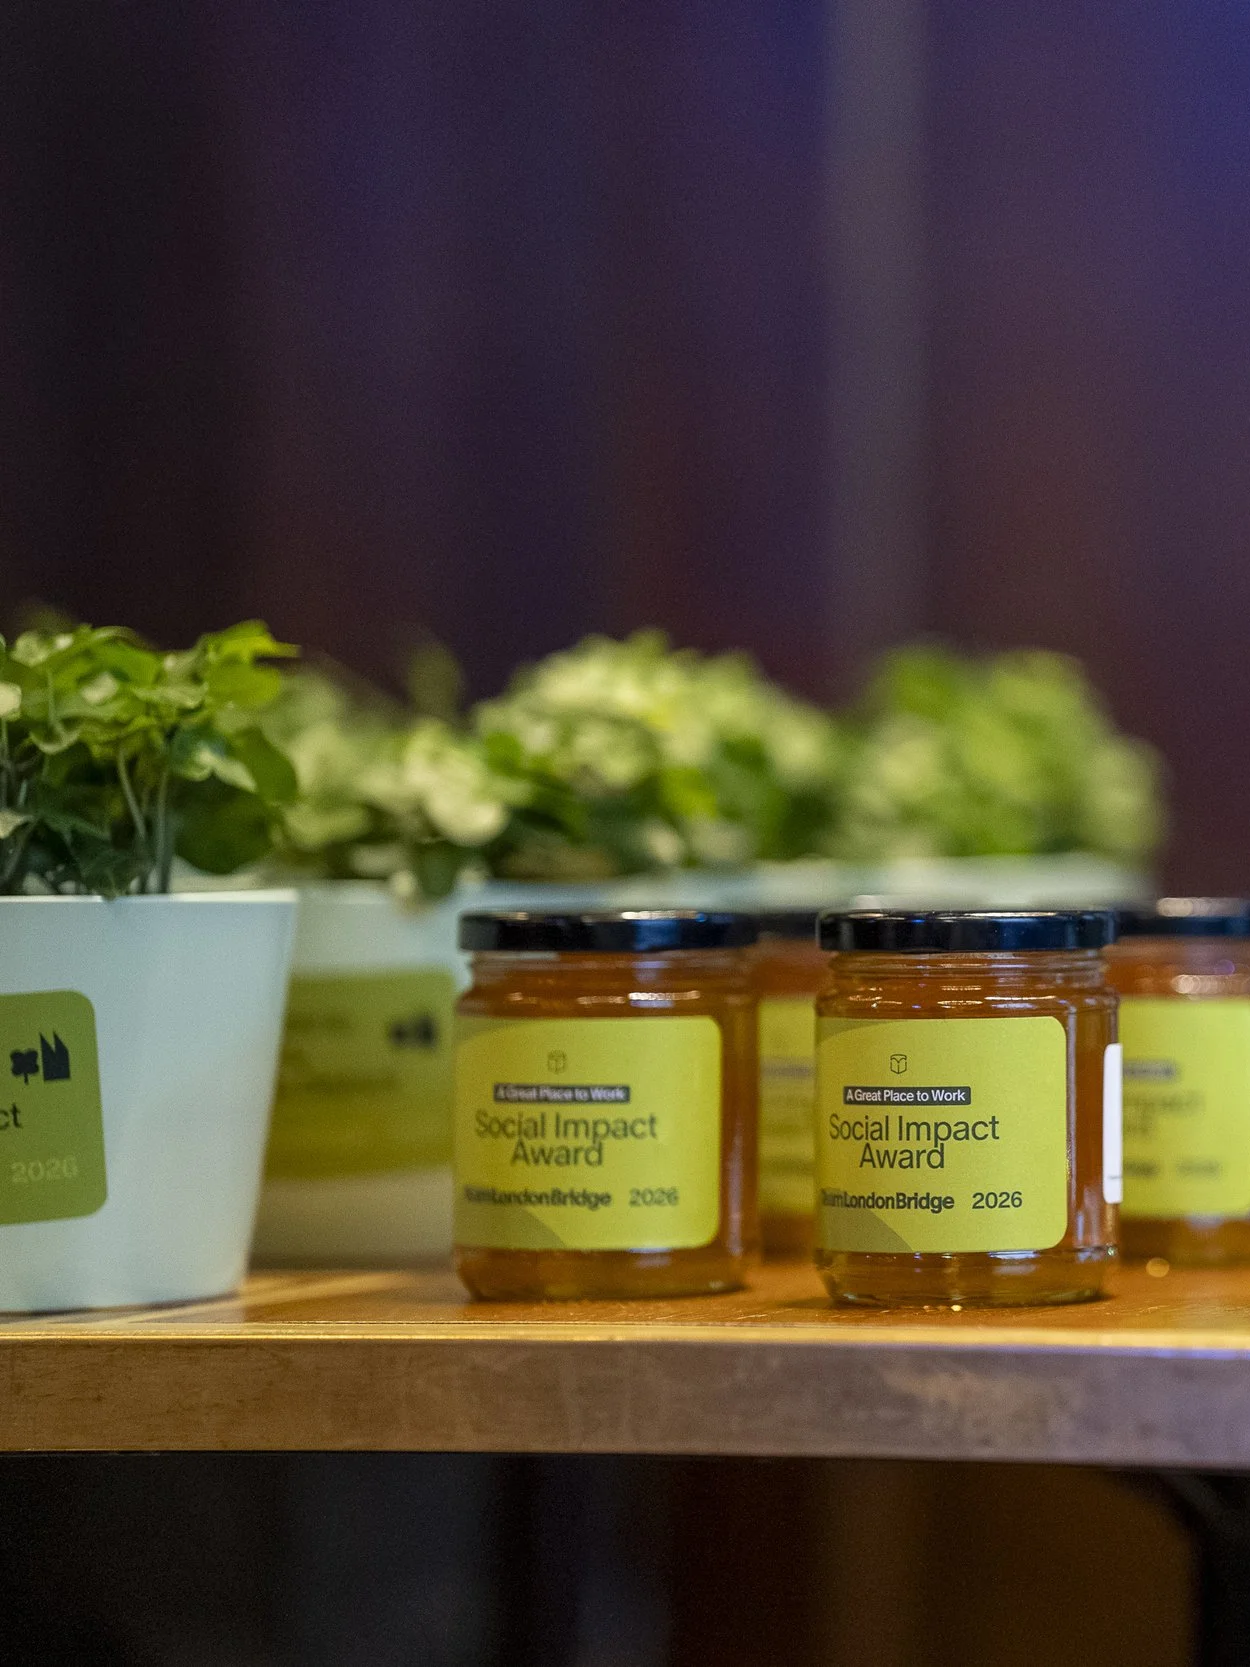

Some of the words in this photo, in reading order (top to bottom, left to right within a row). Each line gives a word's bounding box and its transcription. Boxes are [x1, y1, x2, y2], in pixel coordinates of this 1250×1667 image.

[506, 1086, 537, 1100] Great
[539, 1086, 573, 1100] Place
[574, 1086, 589, 1100] to
[591, 1086, 626, 1100] Work
[846, 1089, 854, 1101] A
[855, 1089, 882, 1102] Great
[883, 1089, 914, 1102] Place
[916, 1089, 929, 1102] to
[931, 1089, 966, 1102] Work
[474, 1109, 546, 1139] Social
[555, 1112, 658, 1145] Impact
[829, 1113, 889, 1141] Social
[898, 1115, 1000, 1147] Impact
[511, 1141, 603, 1166] Award
[859, 1143, 945, 1169] Award
[10, 1155, 79, 1183] 2026
[629, 1186, 679, 1207] 2026
[971, 1191, 1023, 1209] 2026
